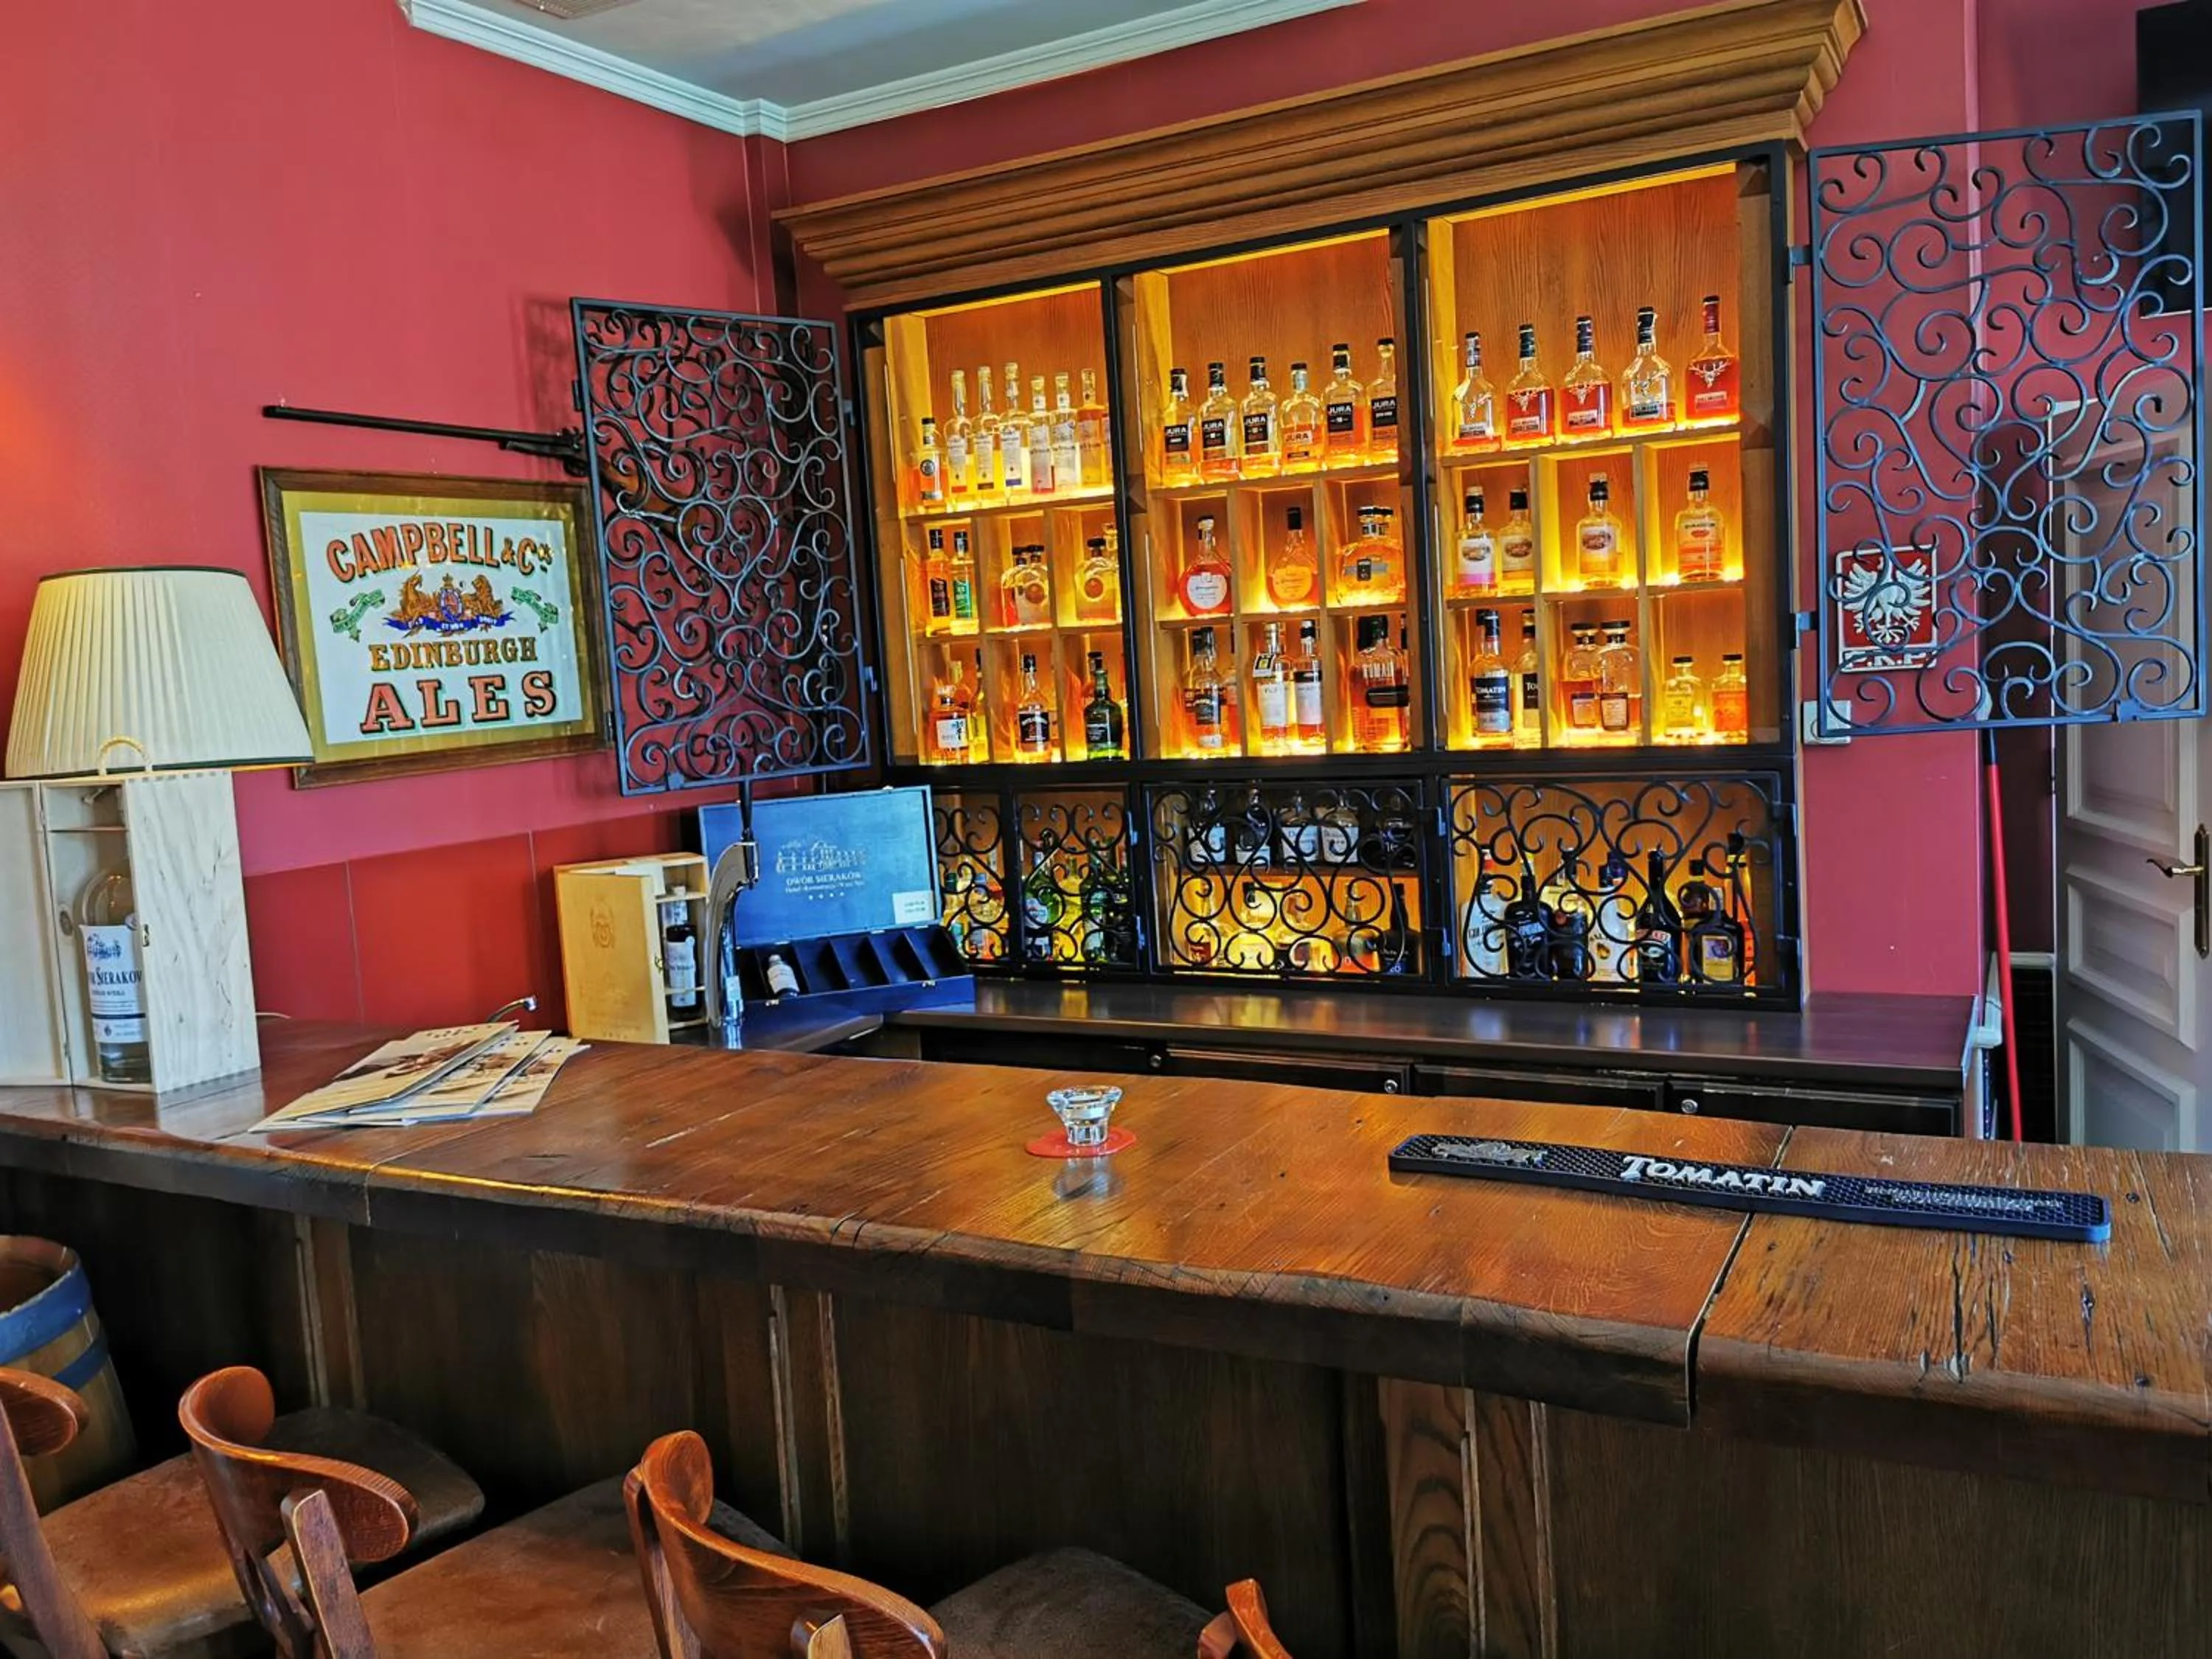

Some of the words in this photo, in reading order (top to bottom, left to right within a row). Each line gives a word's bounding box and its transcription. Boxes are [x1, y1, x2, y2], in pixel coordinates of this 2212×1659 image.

[1329, 405, 1352, 414] JURA
[1372, 399, 1396, 409] JURA
[1245, 415, 1267, 425] JURA
[1284, 433, 1310, 442] JURA
[326, 522, 500, 583] CAMPBELL
[501, 537, 516, 566] &
[369, 636, 538, 671] EDINBURGH
[360, 670, 557, 734] ALES
[1621, 1155, 1827, 1198] TOMATIN
